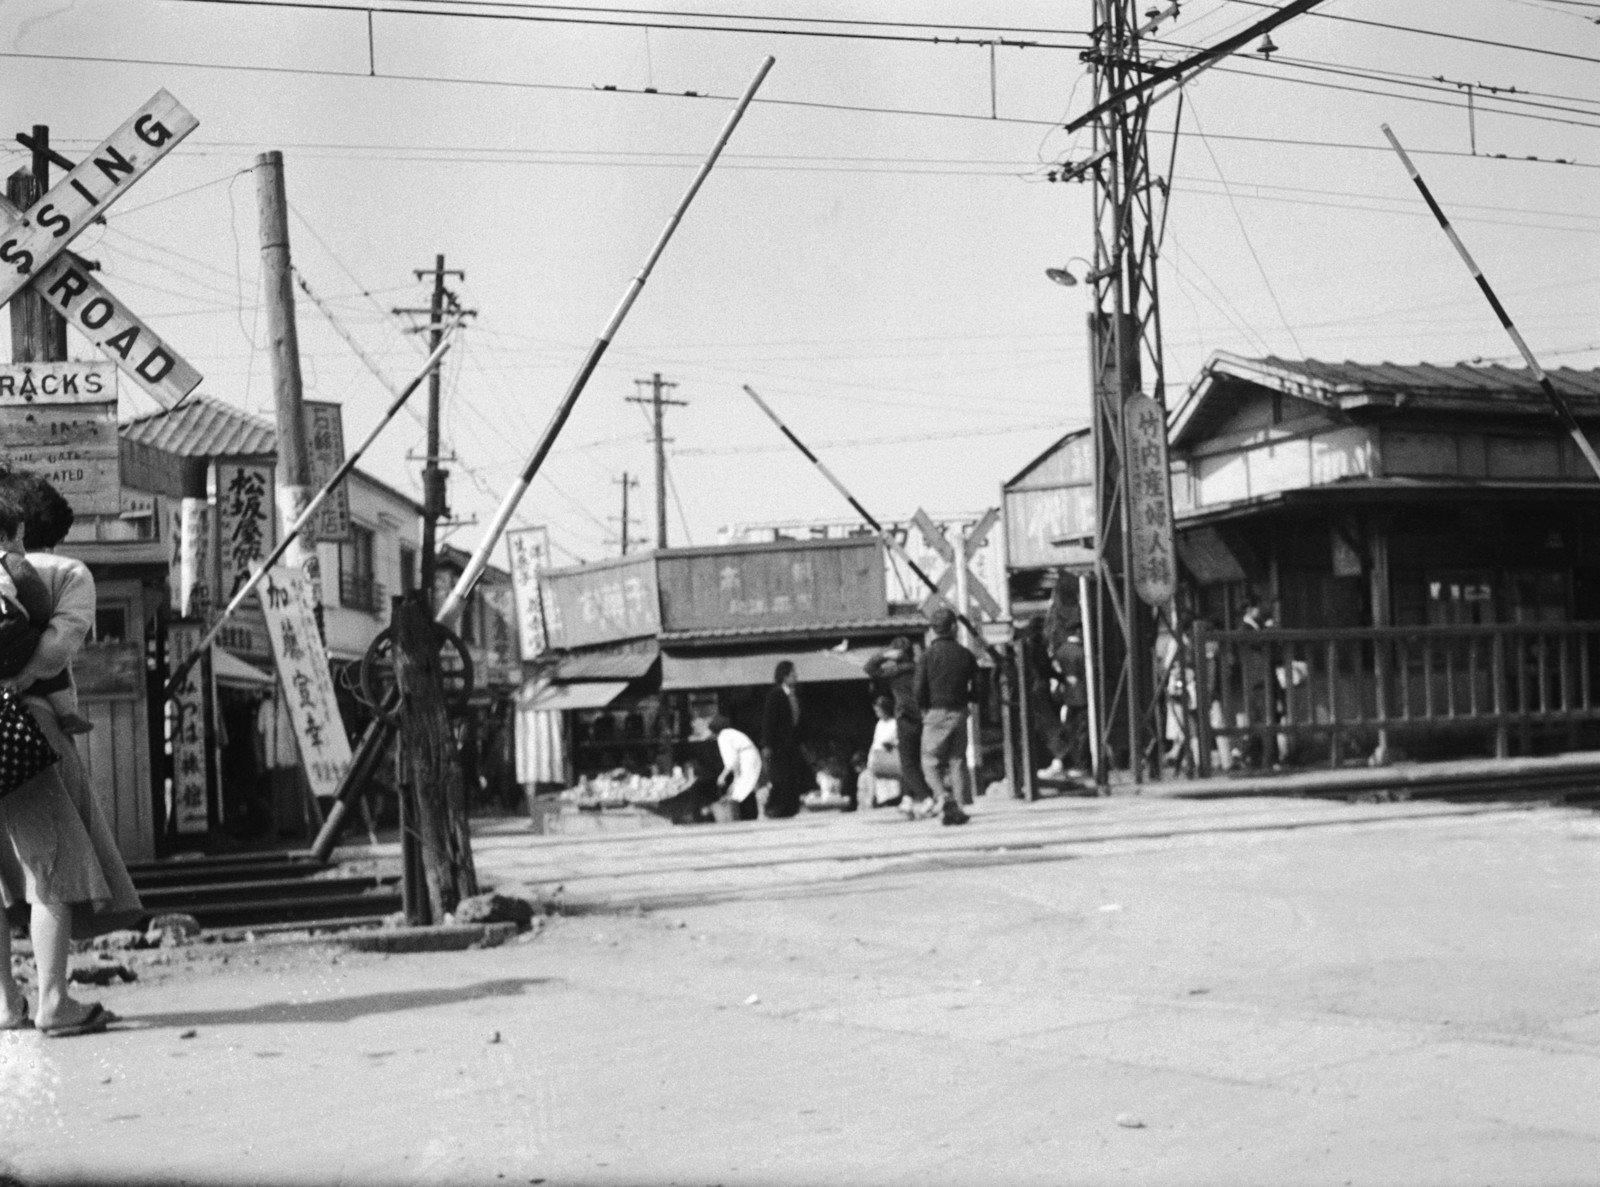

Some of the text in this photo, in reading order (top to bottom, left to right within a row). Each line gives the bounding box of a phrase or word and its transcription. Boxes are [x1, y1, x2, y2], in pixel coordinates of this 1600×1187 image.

[0, 113, 173, 274] SSING
[0, 373, 103, 397] RACKS
[48, 267, 175, 385] ROAD
